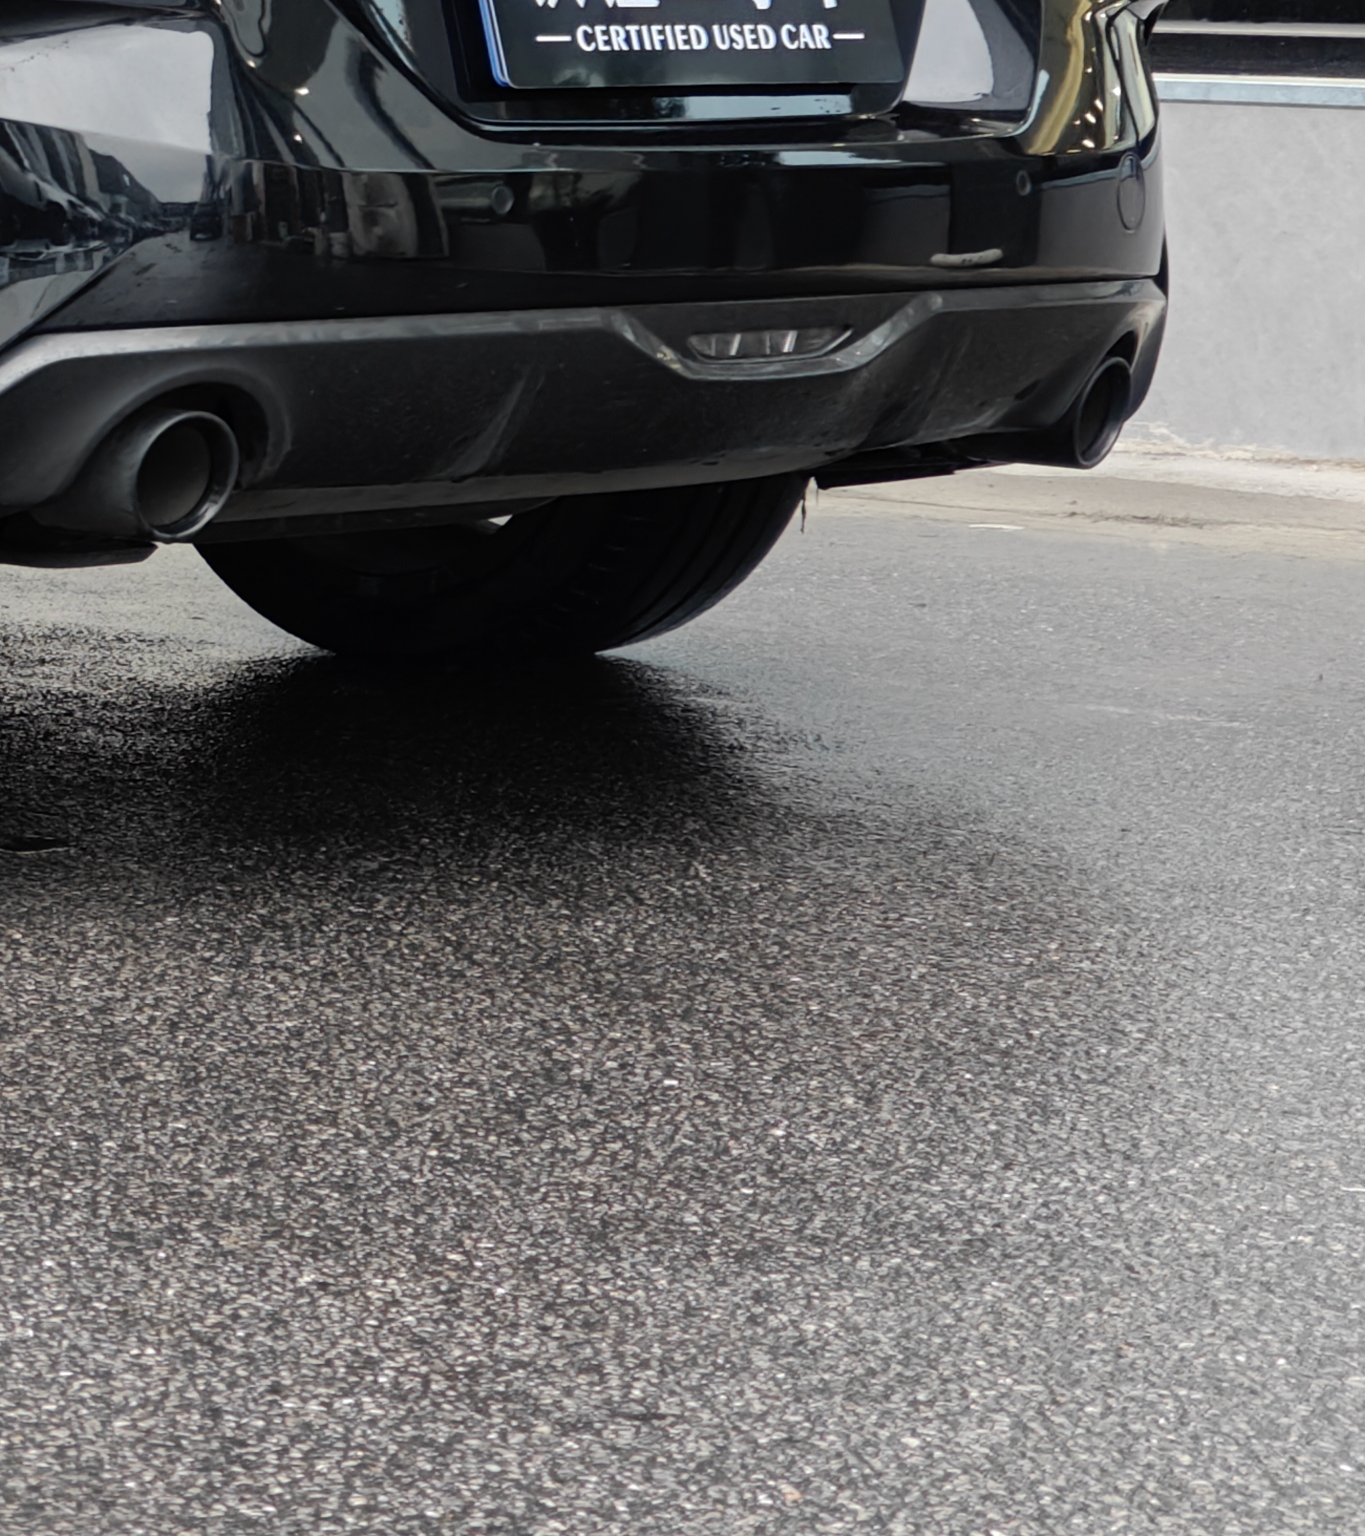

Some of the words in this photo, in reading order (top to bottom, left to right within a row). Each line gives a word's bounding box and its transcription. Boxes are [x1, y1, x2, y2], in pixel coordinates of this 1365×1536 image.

[576, 24, 708, 52] CERTIFIED
[714, 23, 775, 51] USED
[780, 23, 832, 50] CAR
